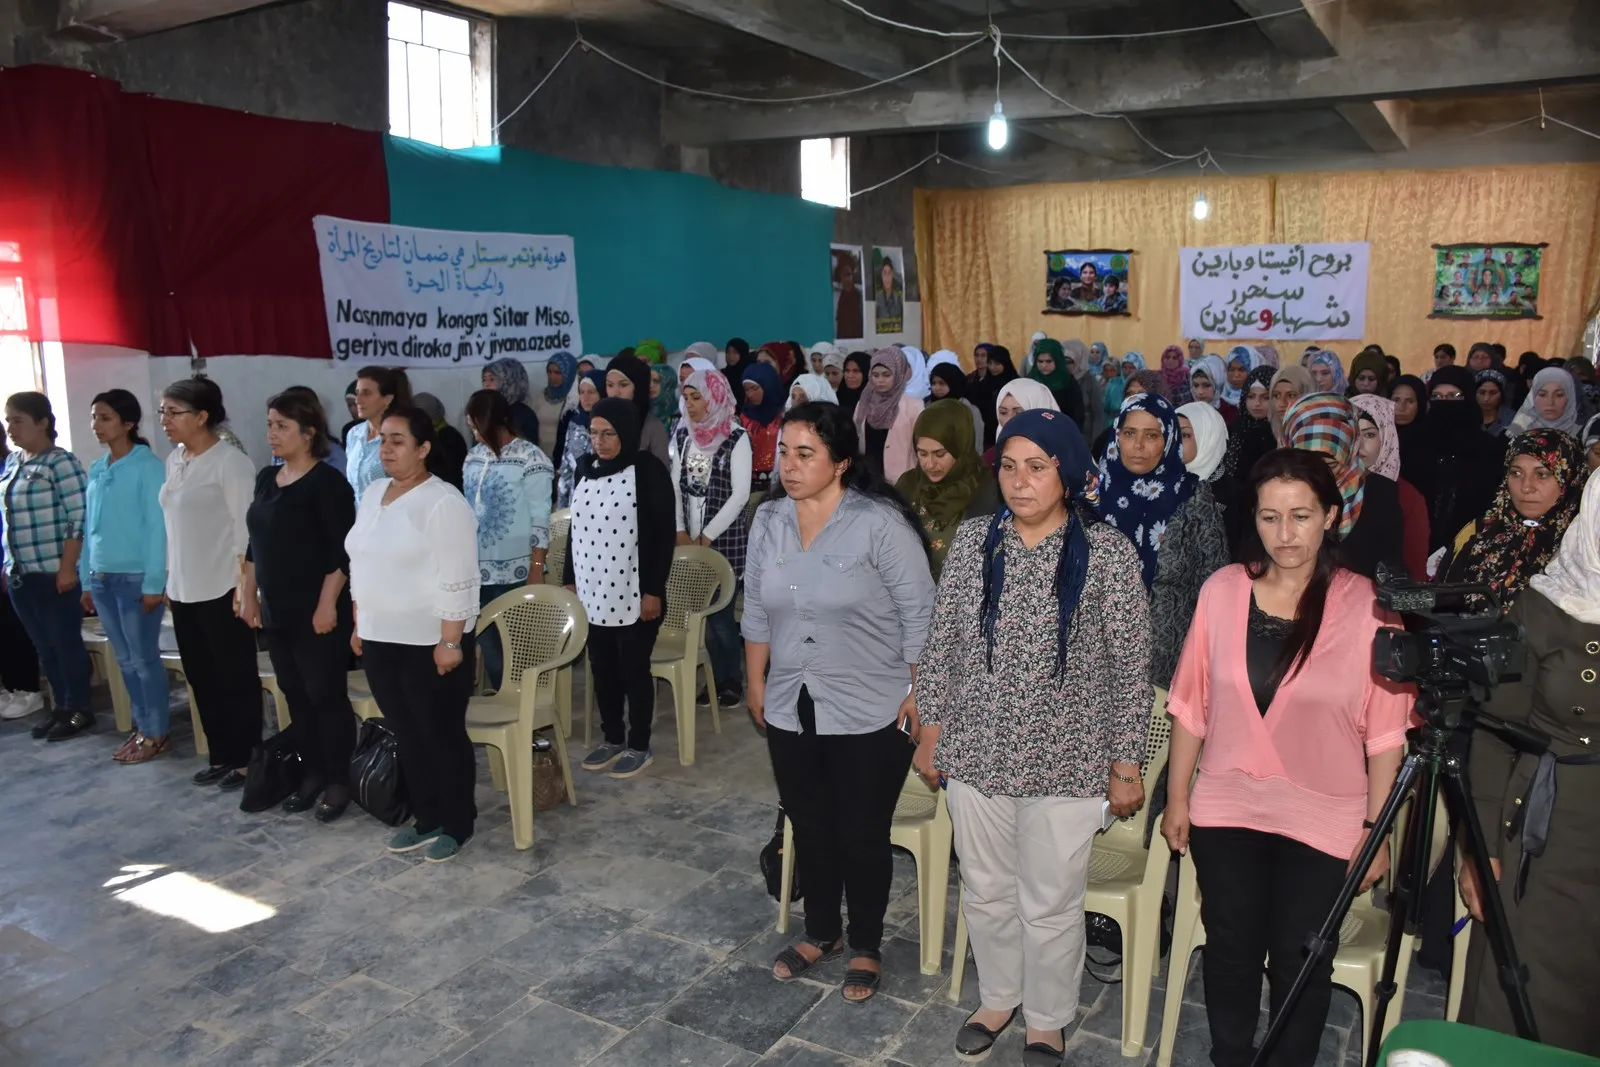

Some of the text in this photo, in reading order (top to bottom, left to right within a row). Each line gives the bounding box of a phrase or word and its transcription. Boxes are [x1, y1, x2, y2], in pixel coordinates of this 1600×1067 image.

[327, 224, 360, 262] المرأة
[402, 233, 449, 265] ضمان
[466, 239, 509, 270] ستار
[542, 245, 567, 271] هوية
[1258, 244, 1306, 276] أفيستا
[1307, 251, 1353, 281] بروح
[405, 267, 505, 298] والحياة الحرة
[1226, 275, 1305, 307] سنحرر
[436, 306, 488, 336] kongra
[492, 304, 530, 327] Sitar
[1272, 295, 1352, 335] شهباء
[336, 331, 400, 361] geriya
[401, 334, 453, 358] diroka
